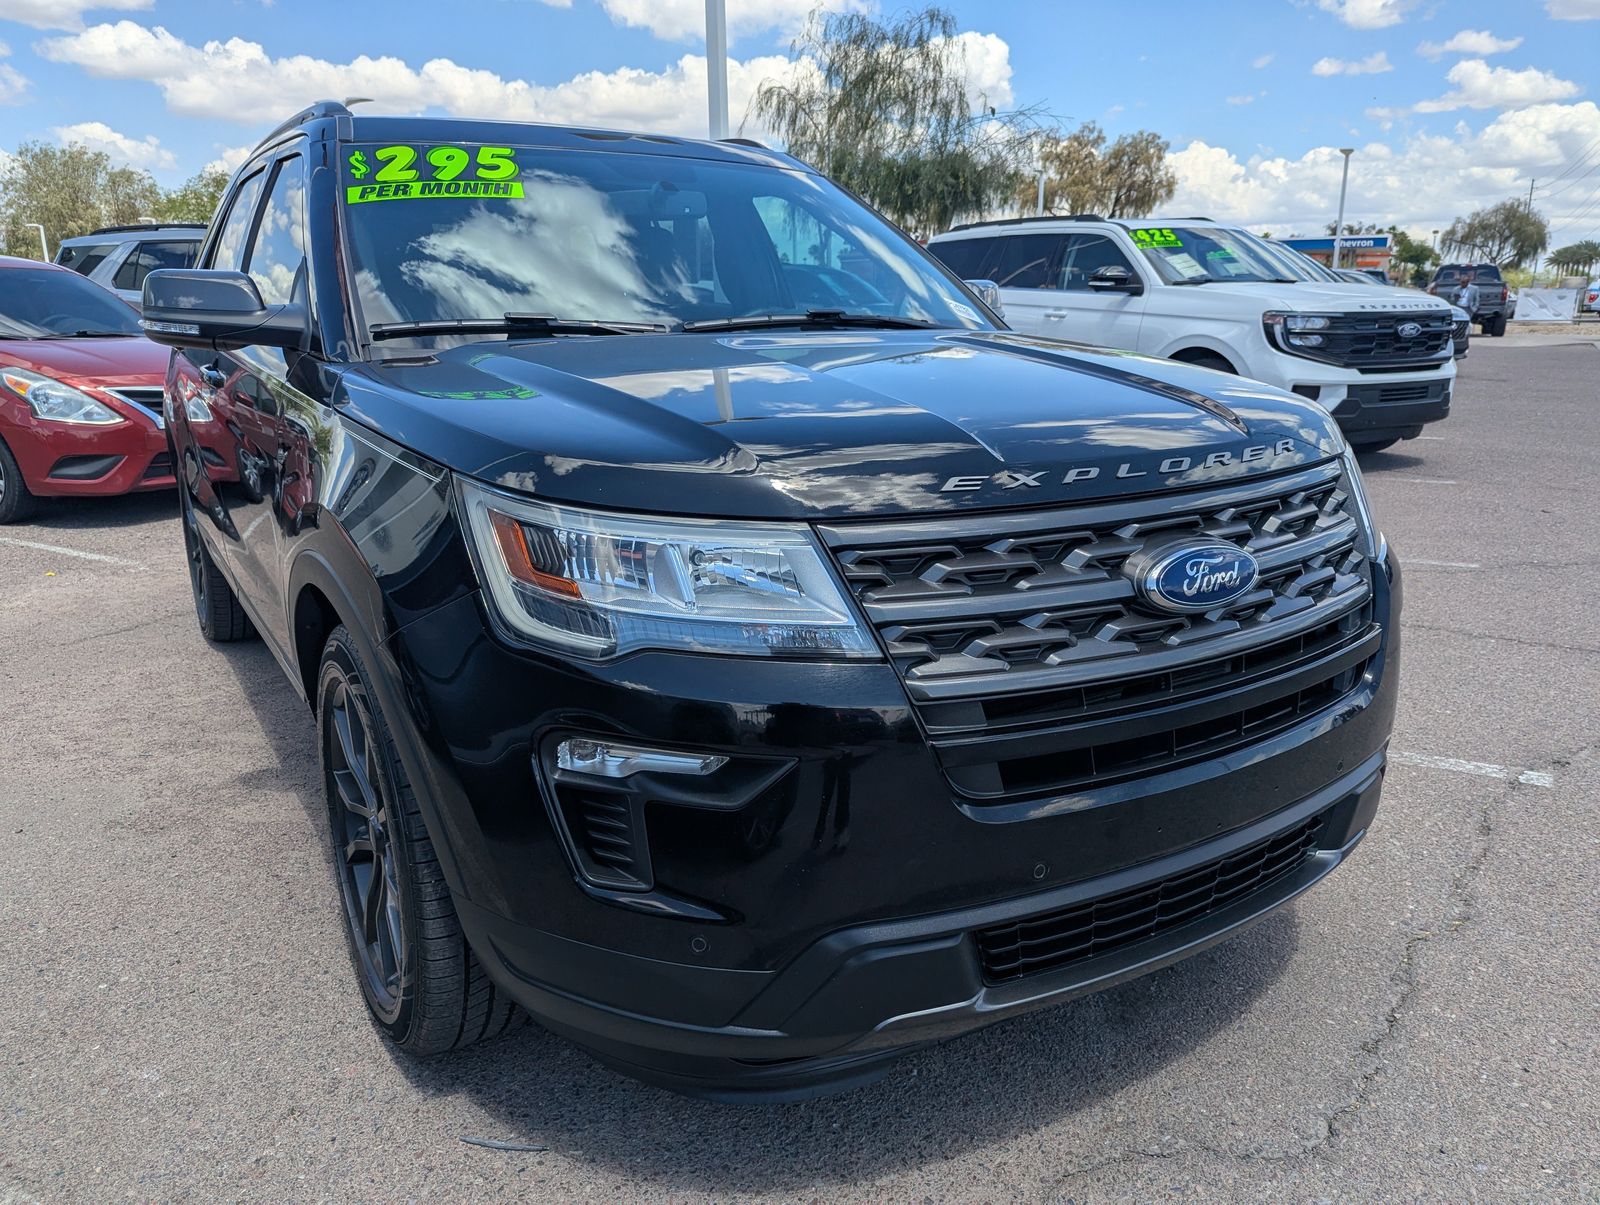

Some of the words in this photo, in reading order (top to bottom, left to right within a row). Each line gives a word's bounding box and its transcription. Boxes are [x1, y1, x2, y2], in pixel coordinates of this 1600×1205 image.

[349, 145, 519, 182] $295
[358, 183, 412, 200] PER
[419, 181, 513, 196] MONTH
[940, 438, 1295, 493] EXPLORER
[1183, 555, 1242, 597] Ford
